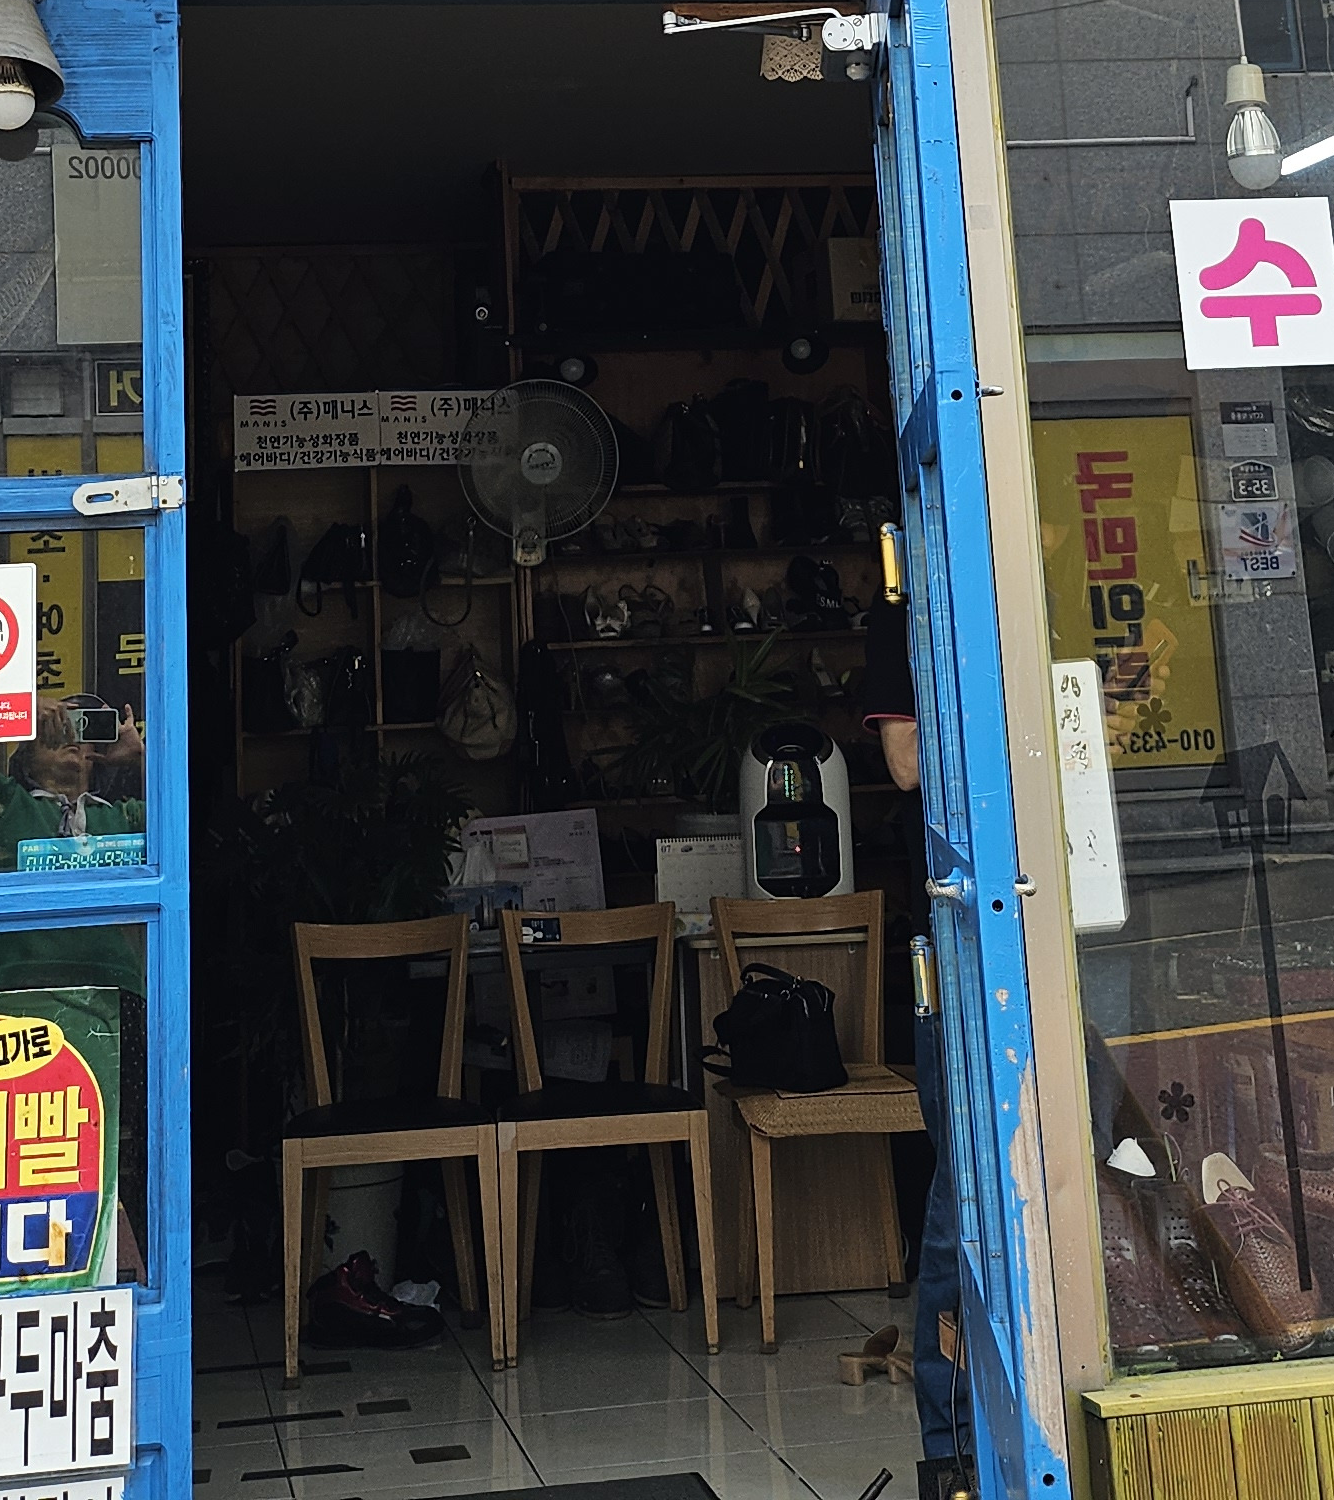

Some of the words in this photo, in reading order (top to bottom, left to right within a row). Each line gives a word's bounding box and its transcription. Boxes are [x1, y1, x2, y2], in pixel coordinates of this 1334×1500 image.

[240, 420, 288, 428] MANIS
[381, 415, 428, 424] MANIS
[256, 432, 360, 449] 천연기능성화장품
